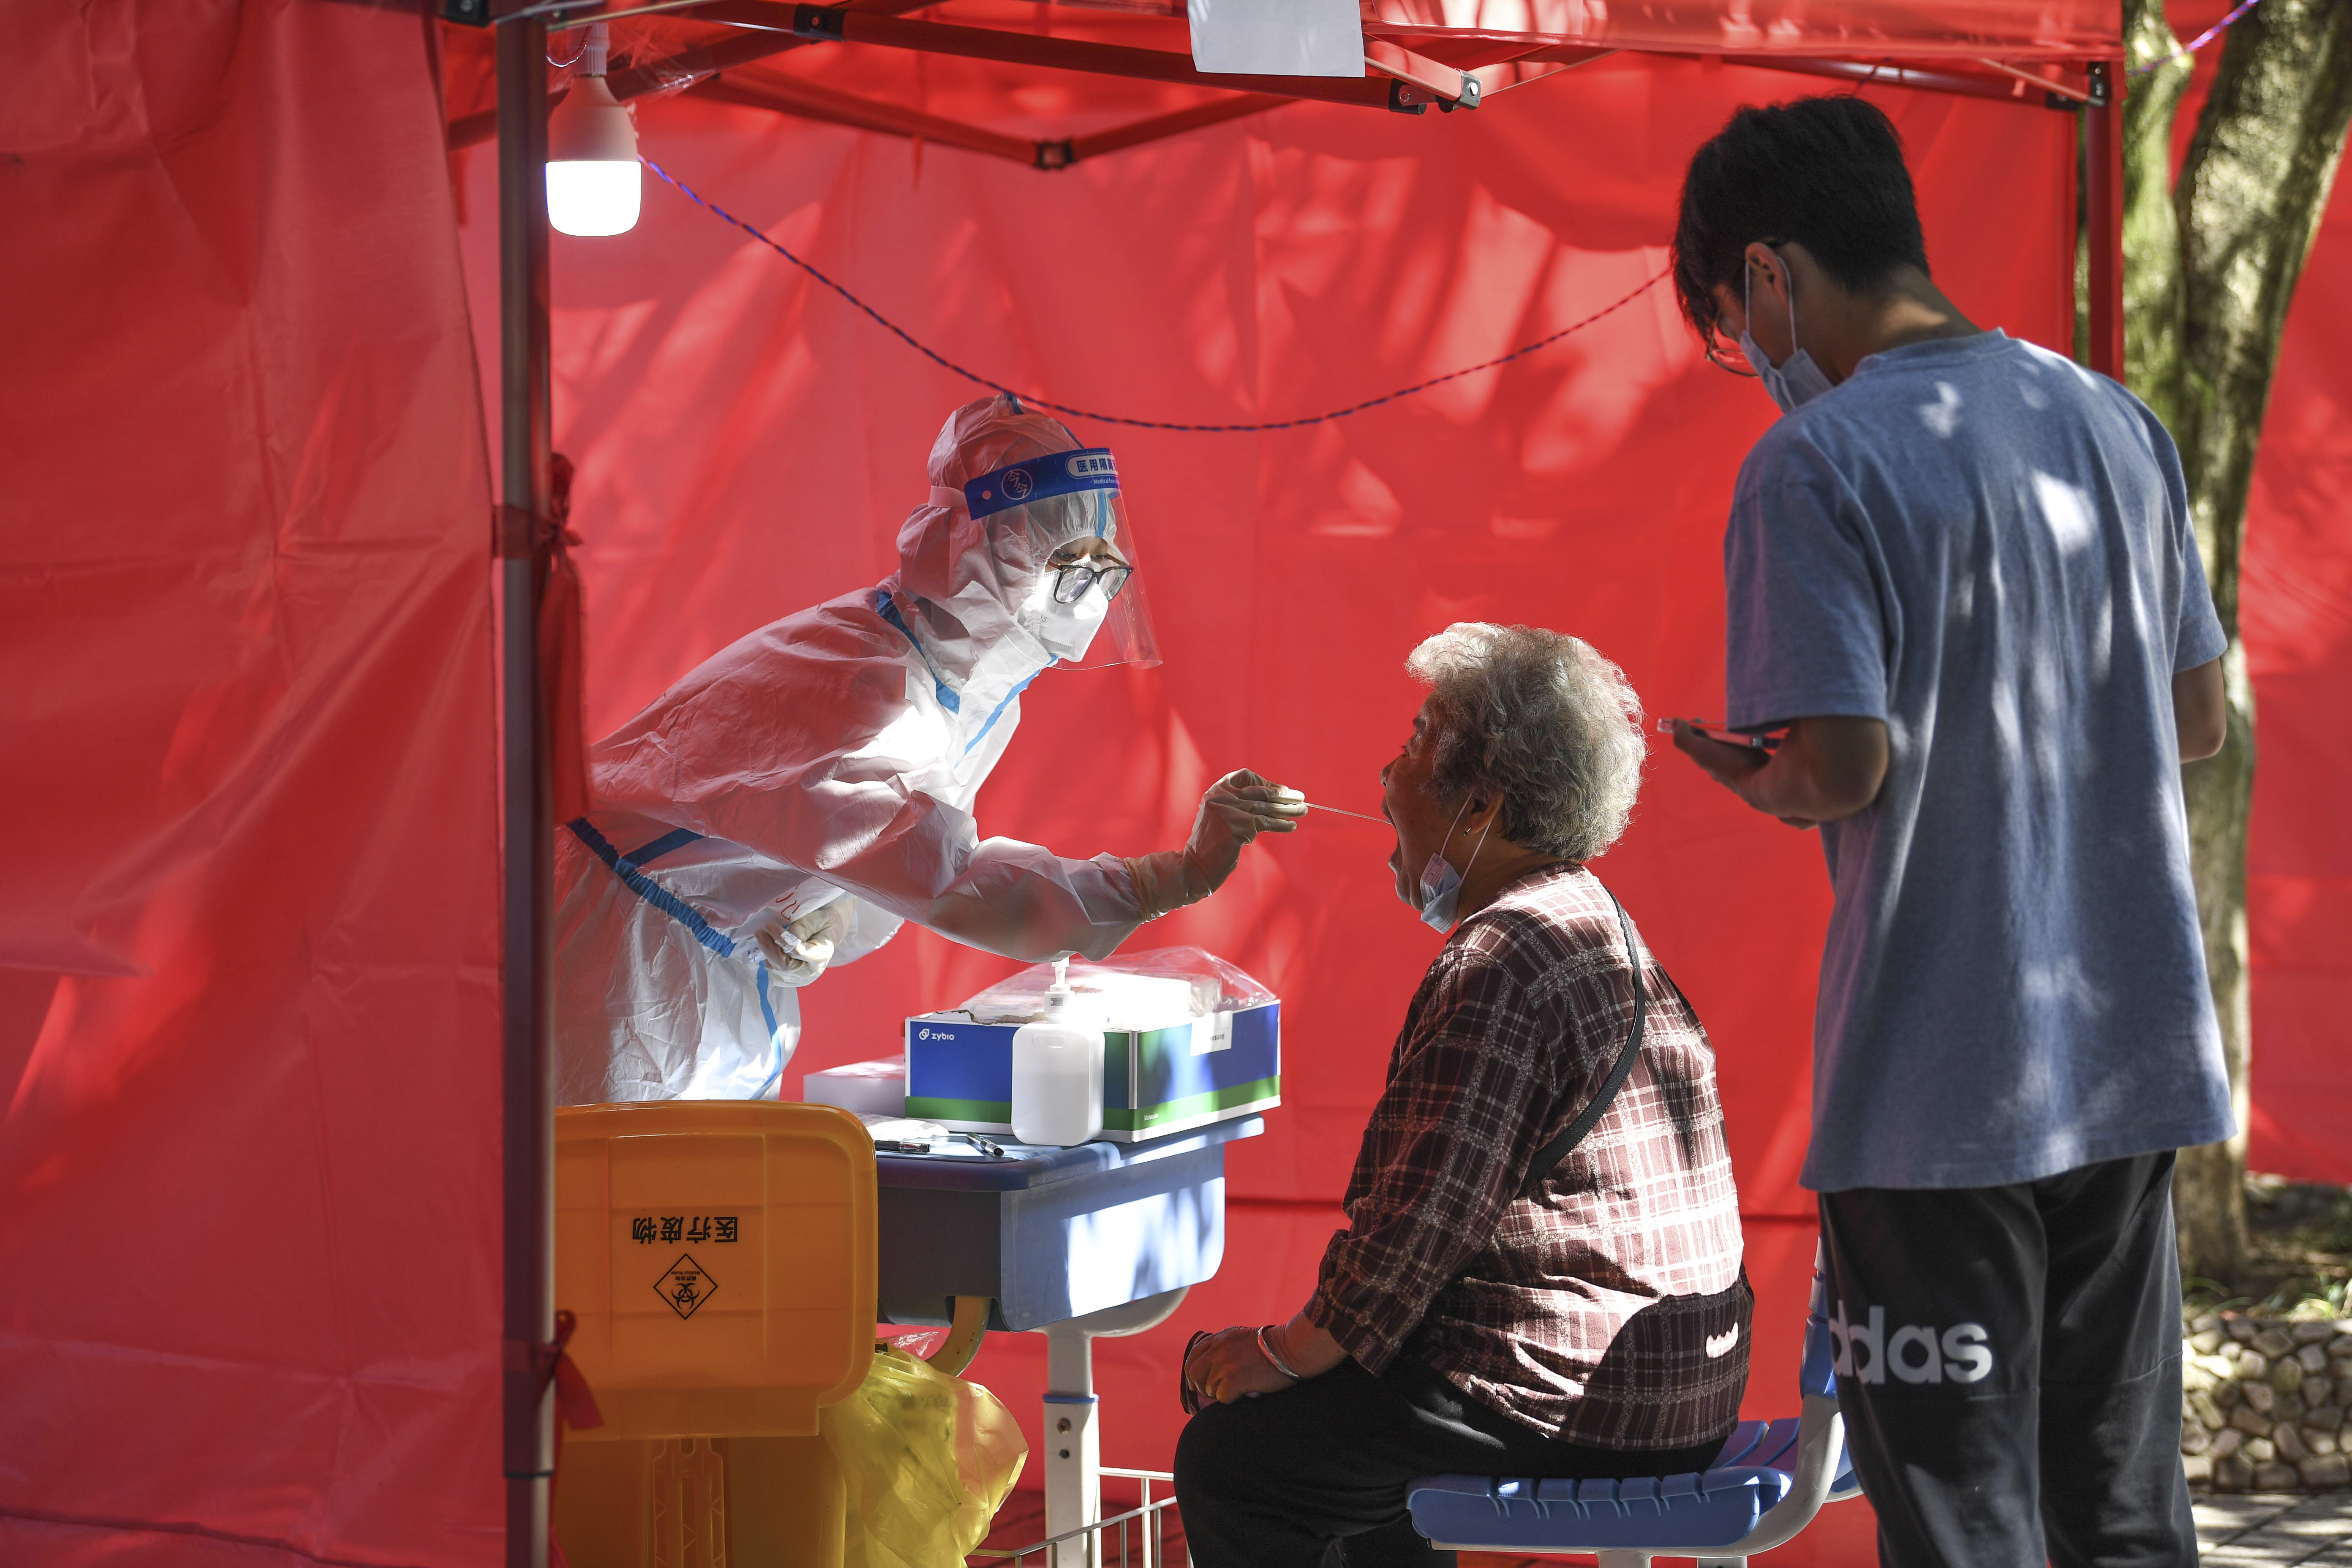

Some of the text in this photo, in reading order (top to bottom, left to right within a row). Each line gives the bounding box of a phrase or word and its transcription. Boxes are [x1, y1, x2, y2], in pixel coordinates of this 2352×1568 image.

[931, 1032, 954, 1041] zybio
[632, 1217, 738, 1244] 医疗废物
